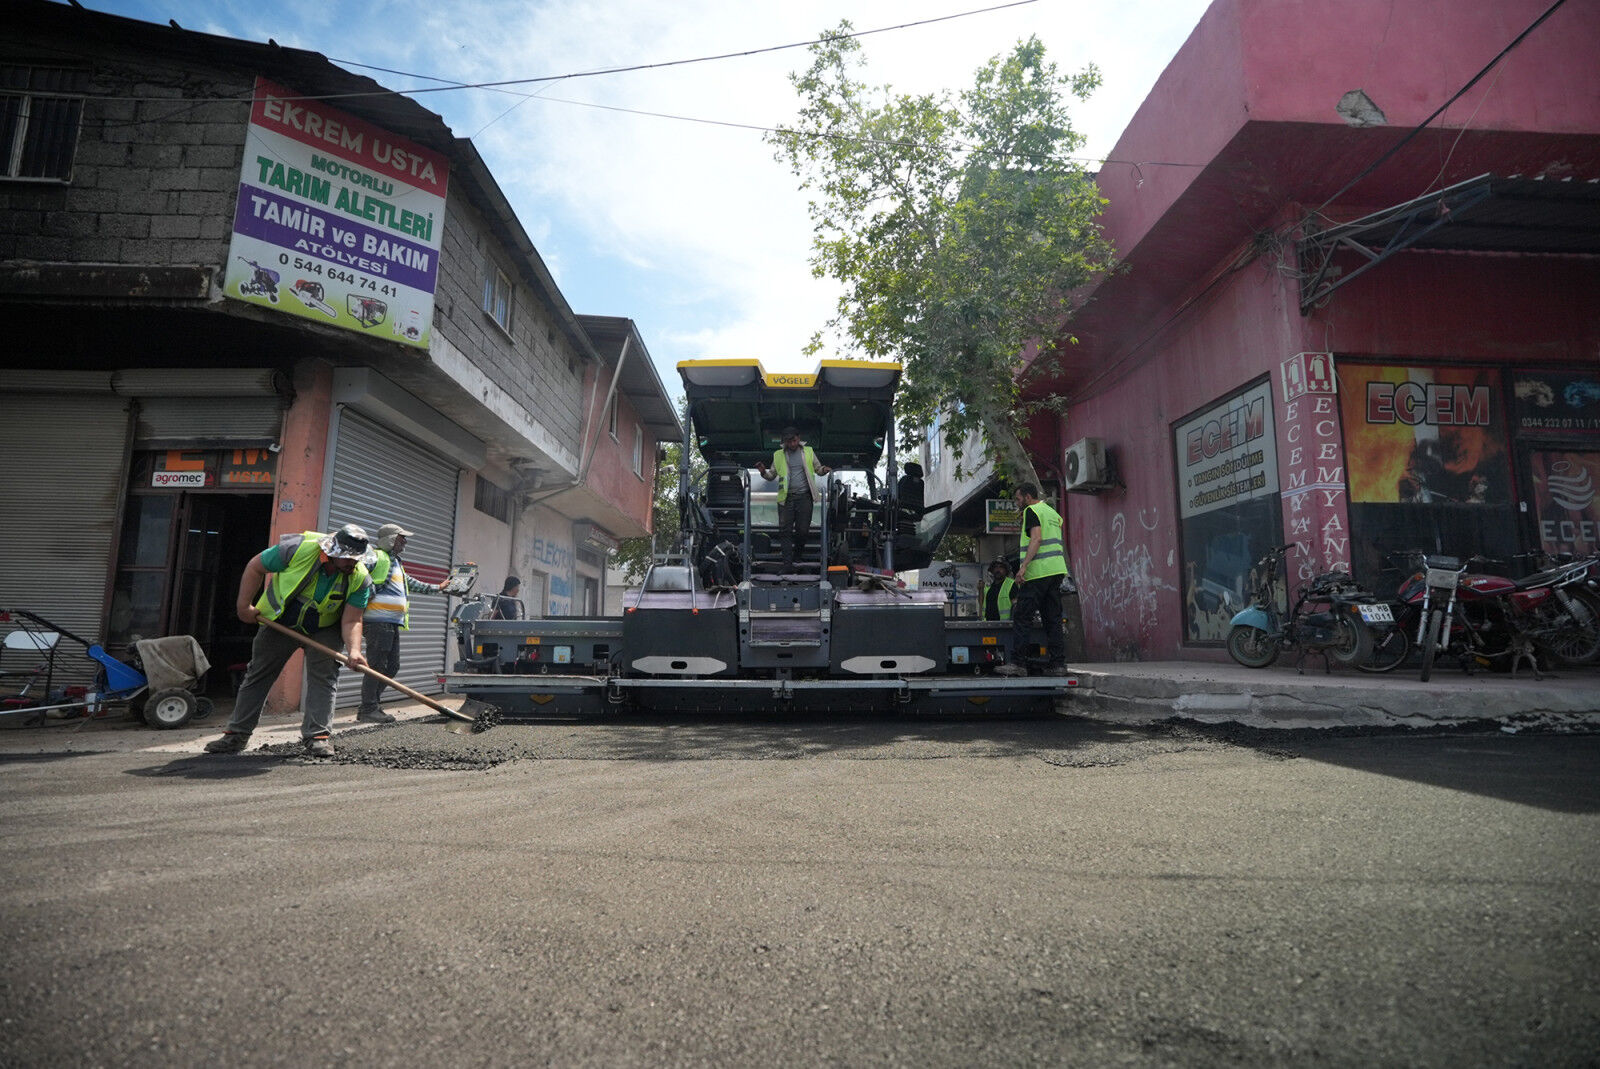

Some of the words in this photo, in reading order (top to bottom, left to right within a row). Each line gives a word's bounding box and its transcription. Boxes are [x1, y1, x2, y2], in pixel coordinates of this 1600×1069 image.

[263, 94, 362, 154] EKREM
[372, 139, 437, 185] USTA
[310, 154, 393, 196] MOTORLU
[257, 155, 331, 205] TARIM
[334, 187, 433, 242] ALETLERİ
[251, 196, 326, 238] TAMİR
[332, 225, 357, 248] ve
[364, 233, 429, 273] BAKIM
[279, 253, 289, 265] 0
[293, 259, 322, 275] 544
[327, 268, 354, 285] 644
[359, 276, 377, 291] 74
[381, 283, 397, 298] 41
[295, 238, 388, 275] ATÖLYESİ
[773, 375, 810, 385] VÖGELE
[1366, 381, 1490, 426] ECEM
[1187, 396, 1264, 467] ECEM
[155, 473, 202, 485] agromec
[229, 471, 272, 483] USTA
[1369, 613, 1392, 621] 1011
